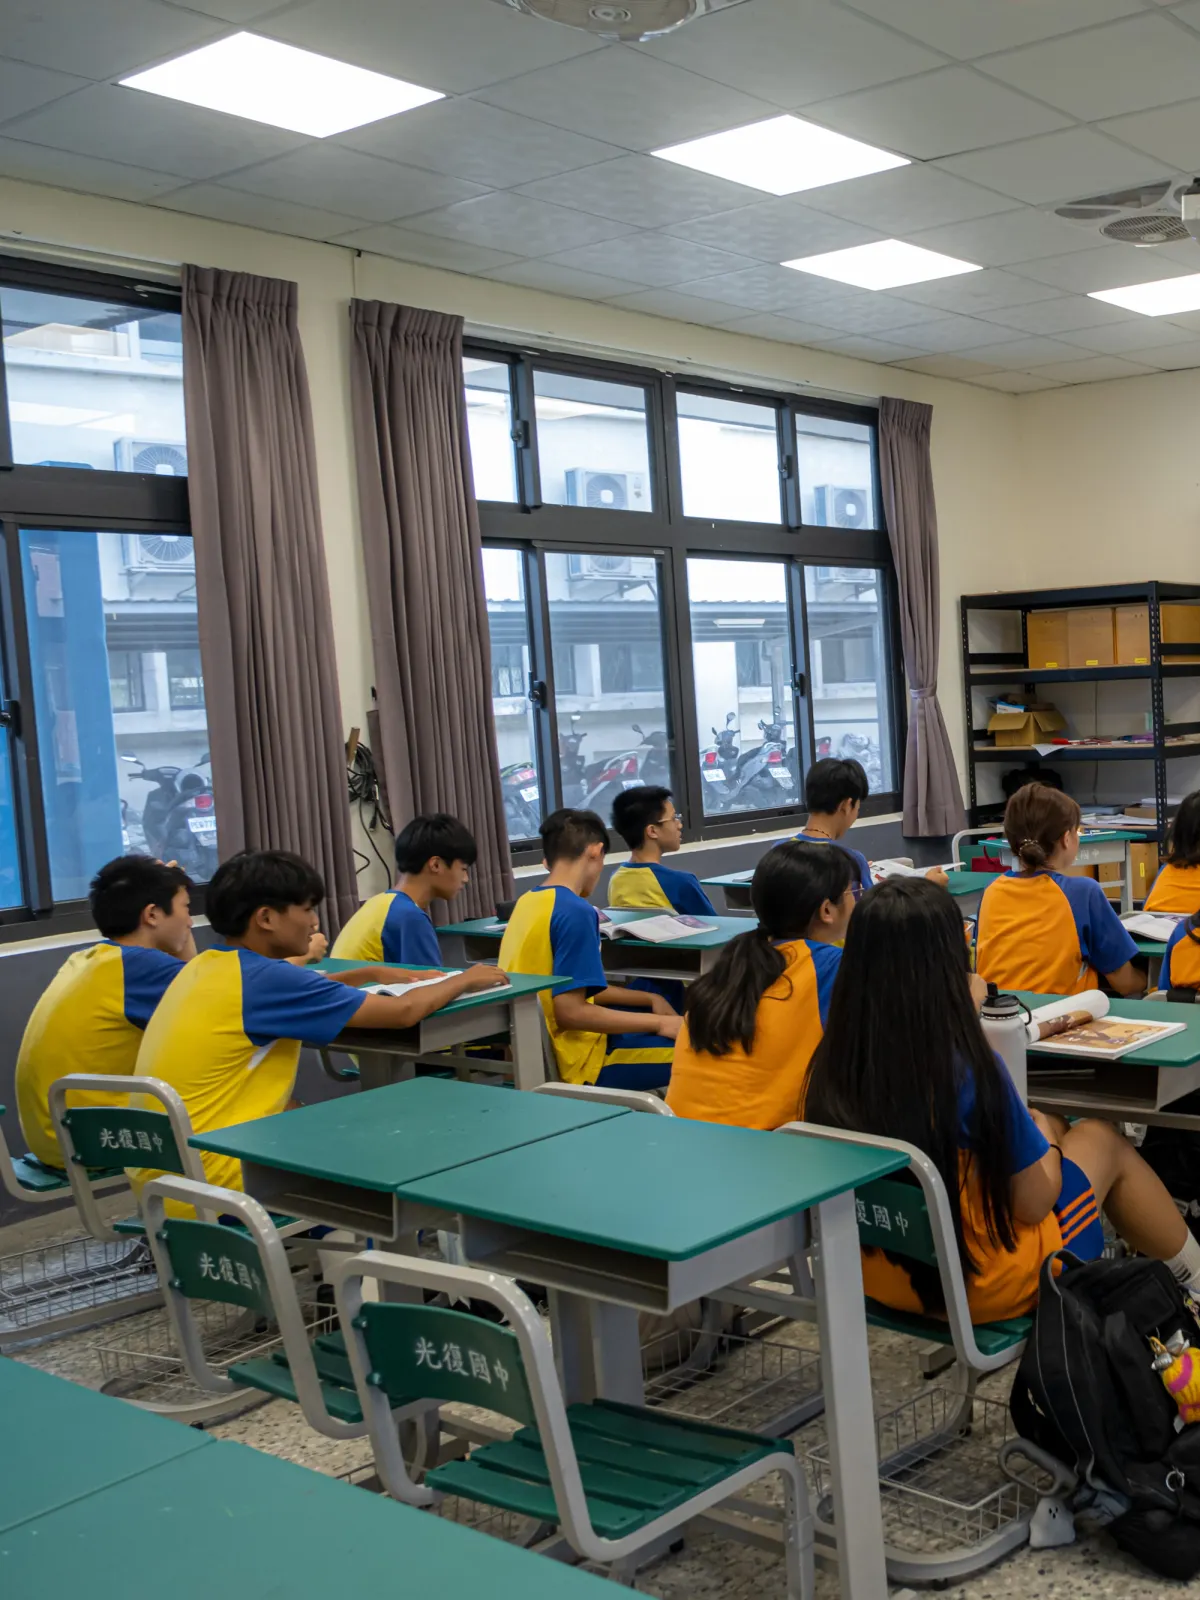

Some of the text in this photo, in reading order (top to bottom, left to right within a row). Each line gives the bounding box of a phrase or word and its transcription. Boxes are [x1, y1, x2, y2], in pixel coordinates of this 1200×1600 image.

[100, 1128, 163, 1154] 光復國中
[200, 1252, 262, 1297] 光復國中
[415, 1336, 509, 1392] 光復國中
